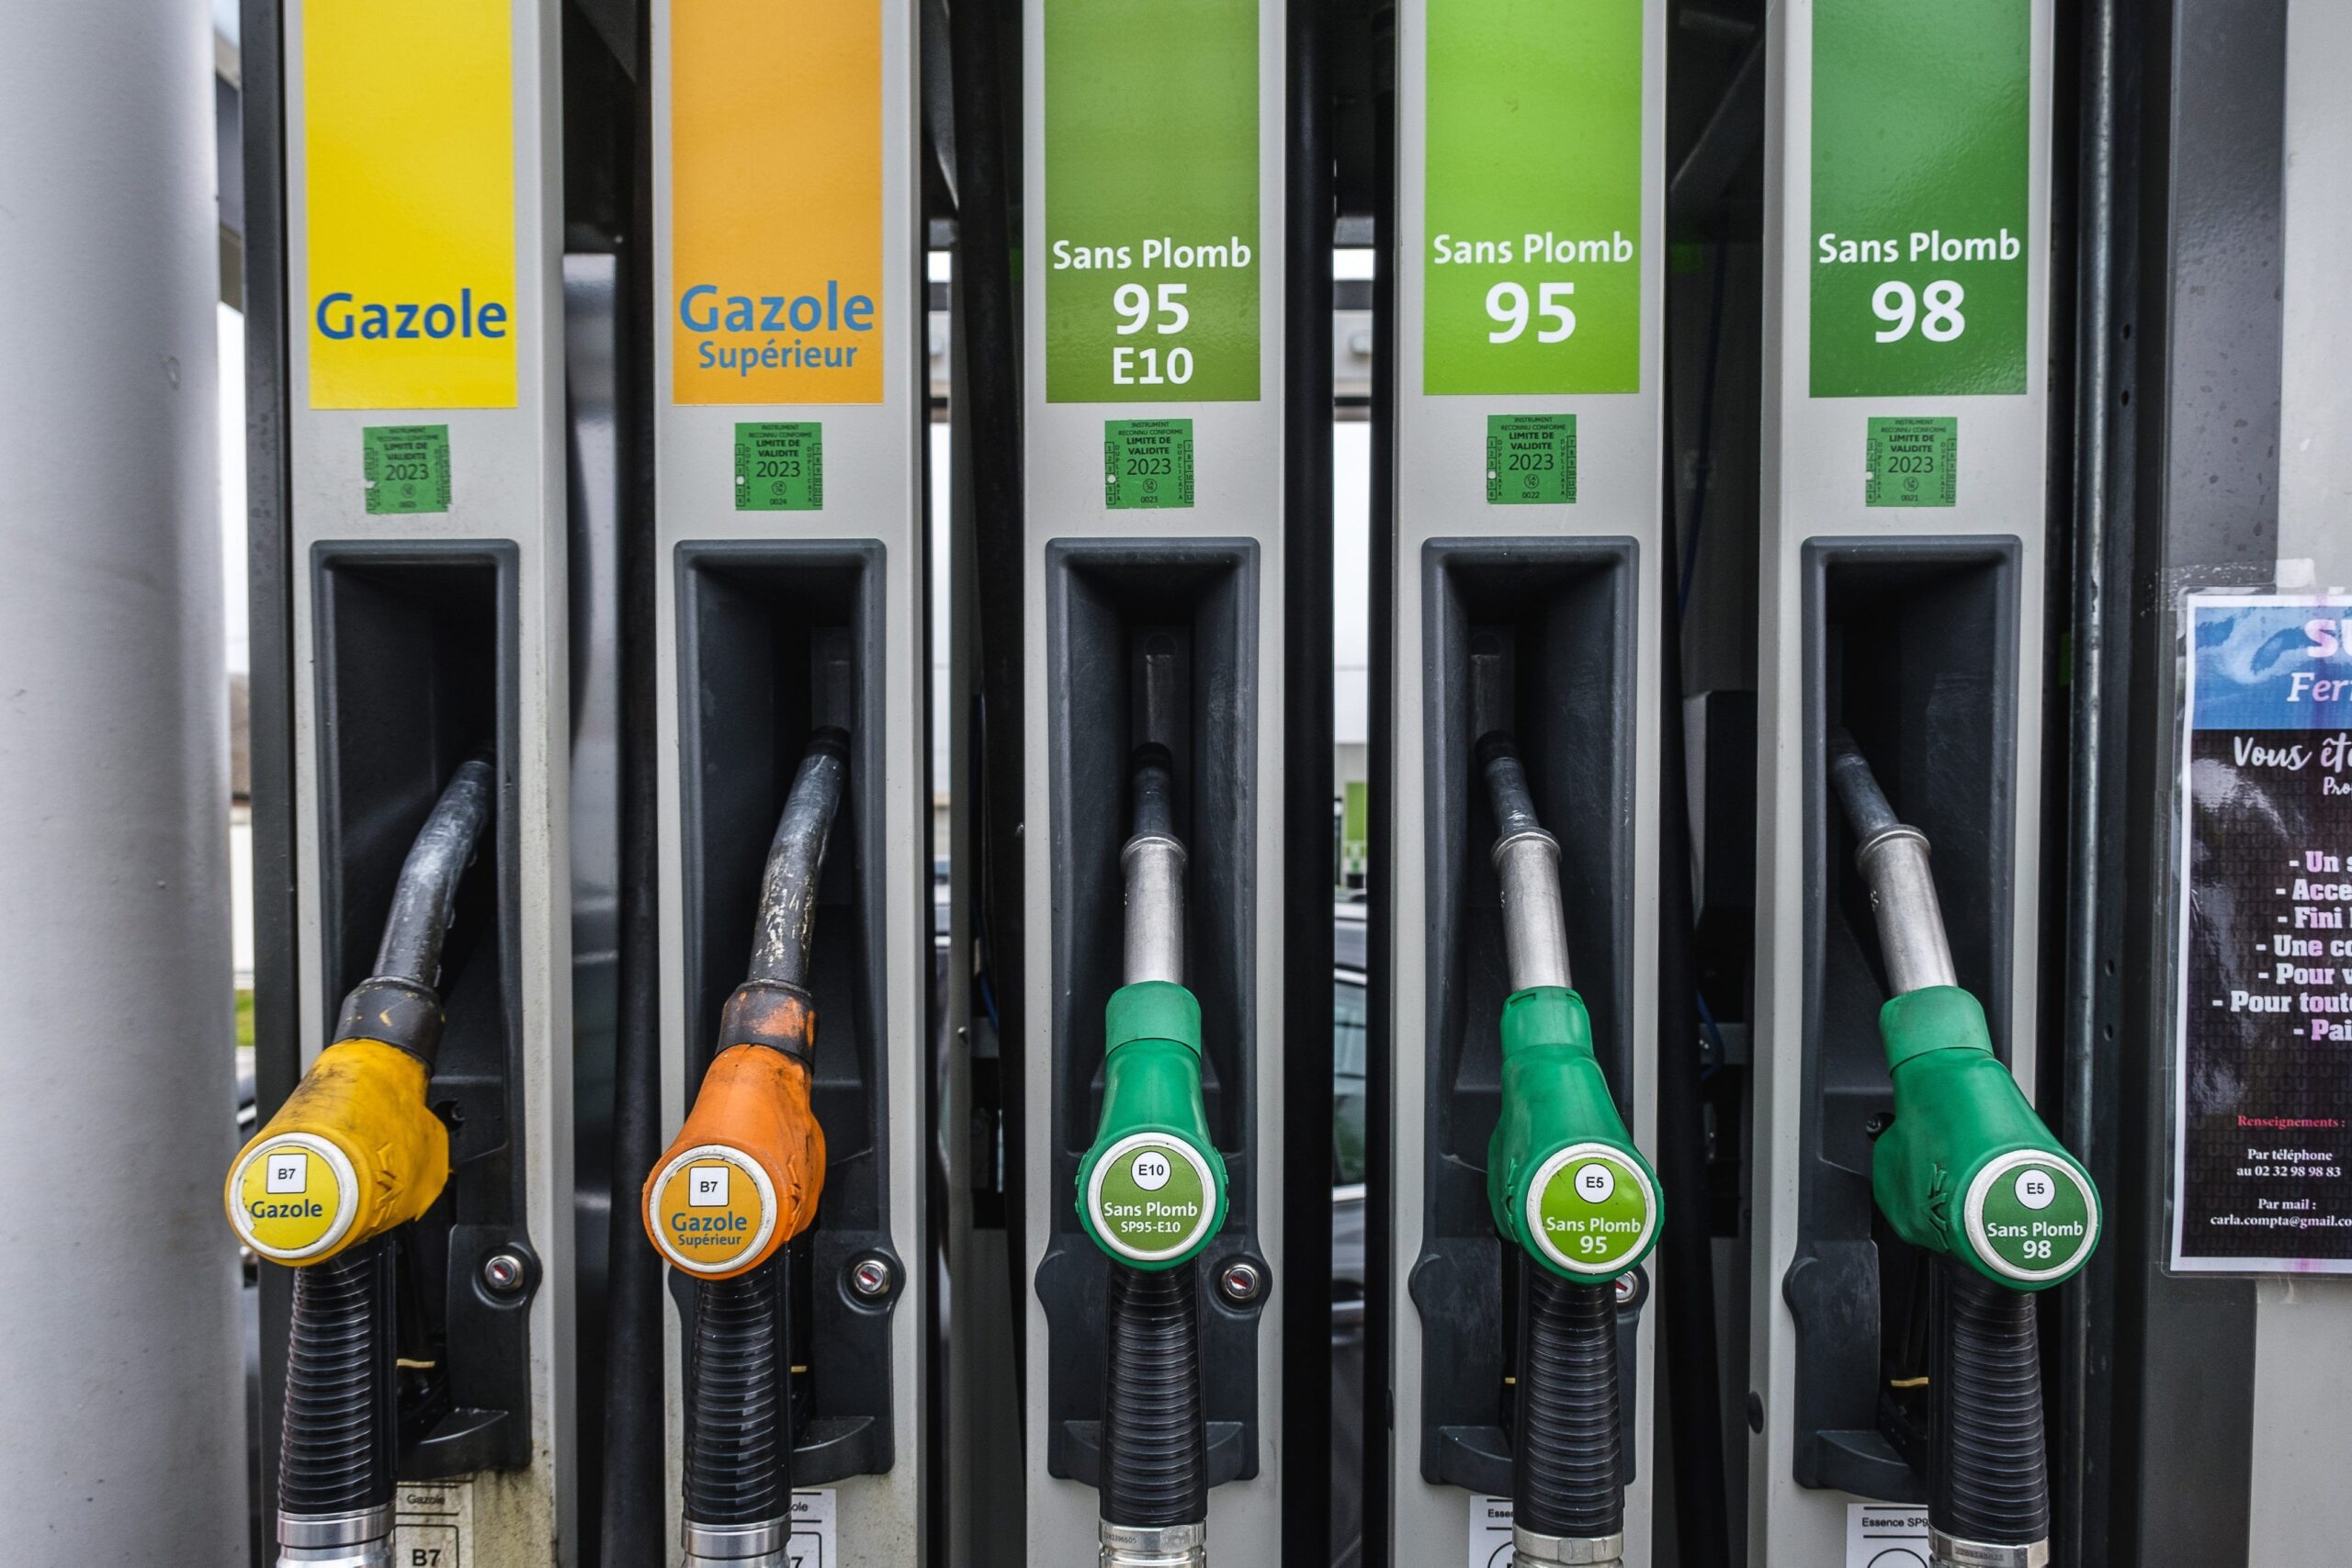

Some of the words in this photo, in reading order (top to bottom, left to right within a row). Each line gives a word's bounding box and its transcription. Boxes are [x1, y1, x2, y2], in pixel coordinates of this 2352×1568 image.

[1052, 240, 1132, 270] Sans
[1143, 236, 1252, 269] Plomb
[1433, 234, 1513, 265] Sans
[1523, 231, 1634, 265] Plomb
[1818, 233, 1899, 265] Sans
[1910, 229, 2020, 263] Plomb
[315, 288, 507, 340] Gazole
[679, 280, 874, 333] Gazole
[1113, 283, 1190, 335] 95
[1486, 282, 1576, 344] 95
[1871, 279, 1965, 344] 98
[698, 338, 857, 377] Supérieur
[1113, 347, 1193, 385] E10
[1510, 432, 1539, 440] LIMITE
[1891, 445, 1933, 453] VALIDITE
[756, 460, 800, 478] 2023
[1126, 458, 1171, 476] 2023
[1509, 454, 1554, 470] 2023
[1888, 456, 1934, 473] 2023
[385, 463, 429, 481] 2023
[2286, 671, 2352, 702] Fer
[2233, 736, 2312, 771] Vous
[2323, 776, 2352, 795] Pro
[2305, 851, 2339, 873] Un
[2294, 906, 2343, 929] Fini
[2273, 934, 2324, 956] Une
[2276, 963, 2335, 985] Pour
[2230, 990, 2292, 1012] Pour
[2300, 992, 2352, 1013] tout
[2237, 1115, 2339, 1130] Renseignements
[2247, 1148, 2269, 1160] Par
[2272, 1148, 2333, 1164] téléphone
[277, 1168, 296, 1180] B7
[1138, 1164, 1164, 1176] E10
[2236, 1168, 2253, 1177] au
[2255, 1166, 2270, 1177] 02
[2272, 1166, 2288, 1177] 32
[2290, 1167, 2306, 1177] 98
[2308, 1167, 2324, 1177] 98
[2325, 1167, 2342, 1177] 83
[700, 1181, 718, 1192] B7
[1586, 1177, 1604, 1189] E5
[2027, 1182, 2045, 1194] E5
[251, 1199, 322, 1219] Gazole
[1103, 1202, 1142, 1217] Sans
[1146, 1201, 1198, 1217] Plomb
[2257, 1198, 2280, 1210] Par
[2282, 1199, 2310, 1210] mail
[672, 1211, 748, 1232] Gazole
[1121, 1221, 1181, 1233] SP95-E10
[1546, 1217, 1586, 1232] Sans
[1590, 1217, 1641, 1233] Plomb
[1987, 1223, 2028, 1237] Sans
[2032, 1221, 2083, 1237] Plomb
[678, 1234, 741, 1249] Supérieur
[1579, 1235, 1608, 1254] 95
[2023, 1240, 2052, 1259] 98
[791, 1501, 808, 1512] ole
[1487, 1508, 1513, 1518] Esse
[1861, 1517, 1905, 1527] Essence
[1907, 1517, 1928, 1527] SP9
[413, 1549, 441, 1567] B7
